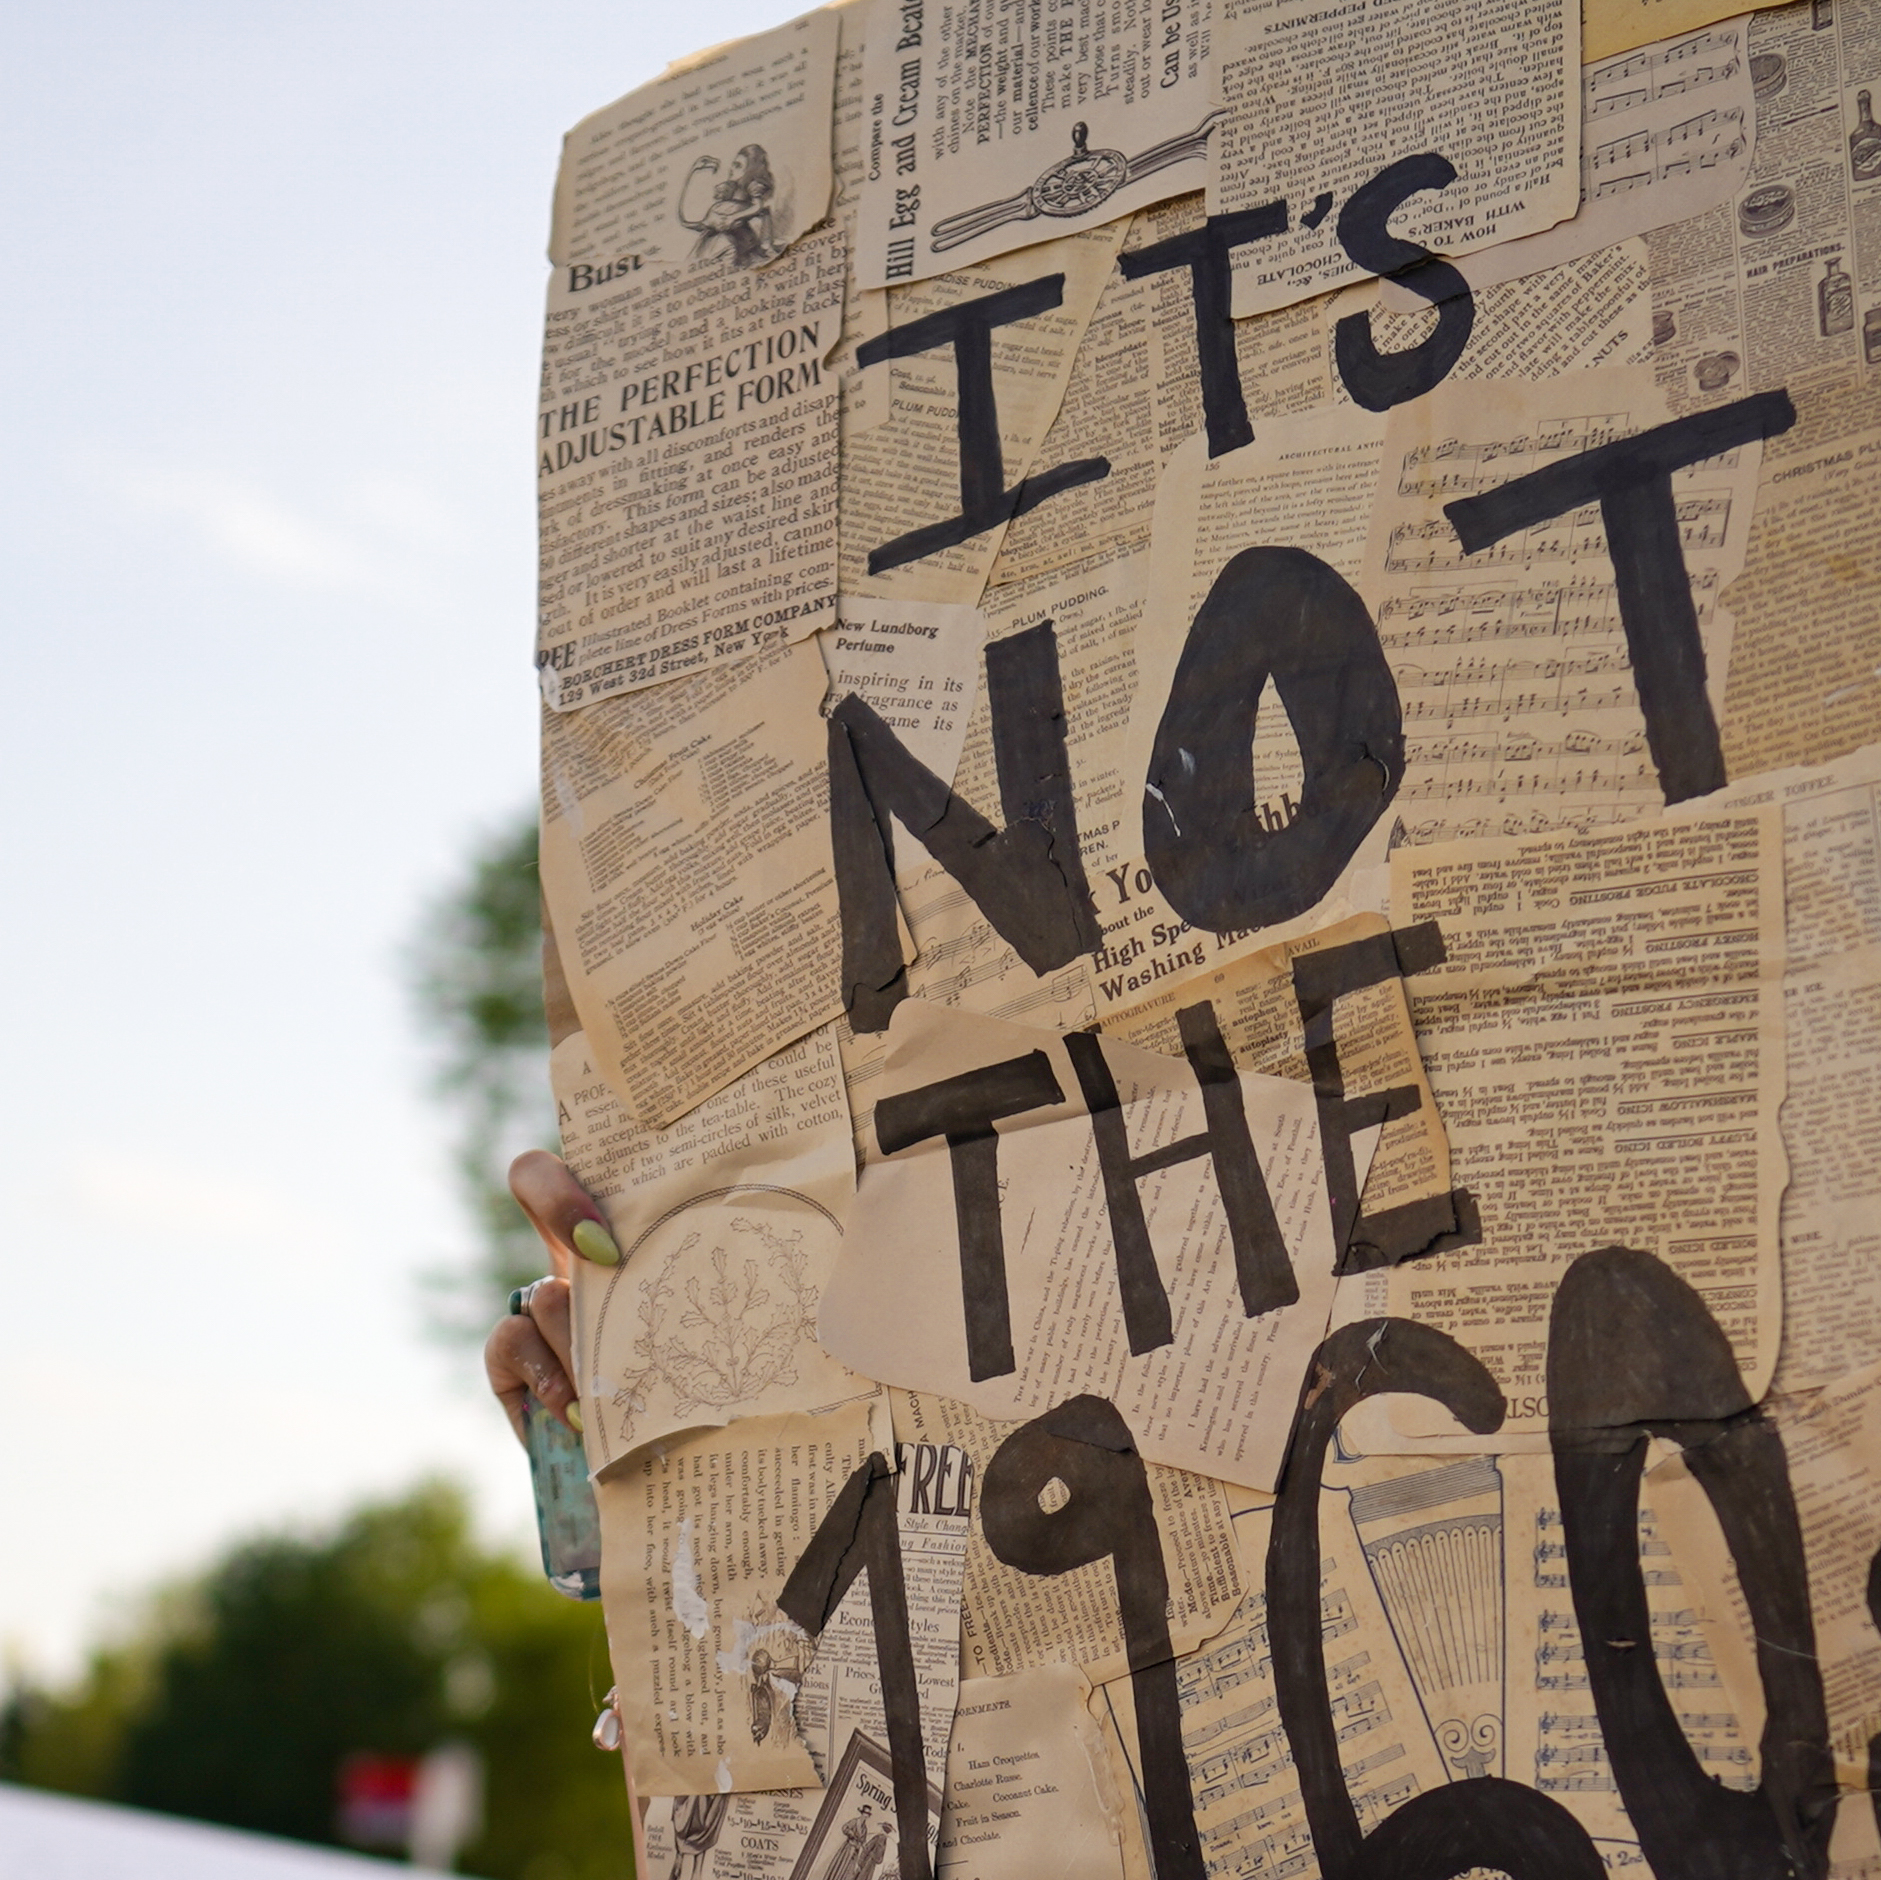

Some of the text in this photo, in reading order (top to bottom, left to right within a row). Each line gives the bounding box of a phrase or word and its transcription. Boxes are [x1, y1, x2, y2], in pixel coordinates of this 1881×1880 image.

[1263, 2, 1366, 36] PEPPERMINTS
[1161, 22, 1181, 89] Can be
[977, 43, 994, 145] PERFECTION
[869, 94, 885, 181] Compare the
[886, 58, 921, 280] Hill Egg and Cream
[1408, 201, 1526, 238] WITH BAKER'S
[1434, 224, 1497, 248] HOW TO
[1256, 252, 1343, 286] CHOCOLATE
[1746, 264, 1769, 278] HAIR
[541, 321, 820, 439] THE PERFECTION
[857, 152, 1476, 577] IT'S
[539, 357, 822, 478] ADJUSTABLE FORM
[1772, 451, 1854, 484] CHRISTMAS
[657, 571, 793, 624] Booklet containing
[659, 576, 835, 640] Dress Forms with prices.
[649, 592, 838, 663] DRESS FORM COMPANY
[835, 618, 939, 640] New Lundborg
[1011, 609, 1047, 629] PLUM
[836, 638, 895, 654] Perfume
[559, 686, 583, 707] 129
[589, 673, 624, 695] West
[629, 660, 656, 682] 32d
[660, 648, 709, 674] Street,
[714, 636, 745, 658] New
[838, 670, 963, 693] inspiring its
[827, 388, 1797, 1033] NOT
[934, 717, 953, 732] its
[723, 896, 745, 911] Cake
[1133, 904, 1155, 922] the
[1091, 940, 1145, 975] High
[1099, 942, 1207, 1003] Washing
[1101, 993, 1177, 1030] AUTOGRAVURE
[701, 1074, 838, 1128] tea-table. The cozy
[801, 1091, 842, 1112] velvet
[702, 1110, 844, 1164] padded with cotton,
[875, 920, 1482, 1383] THE
[904, 1516, 930, 1532] Style
[918, 1673, 955, 1688] Lowest
[968, 1758, 991, 1770] Ham
[856, 1773, 892, 1812] Spring
[954, 1778, 993, 1791] Charlotte
[1034, 1784, 1059, 1795] Cake.
[956, 1809, 1022, 1828] Fruit Season.
[740, 1836, 779, 1851] COATS
